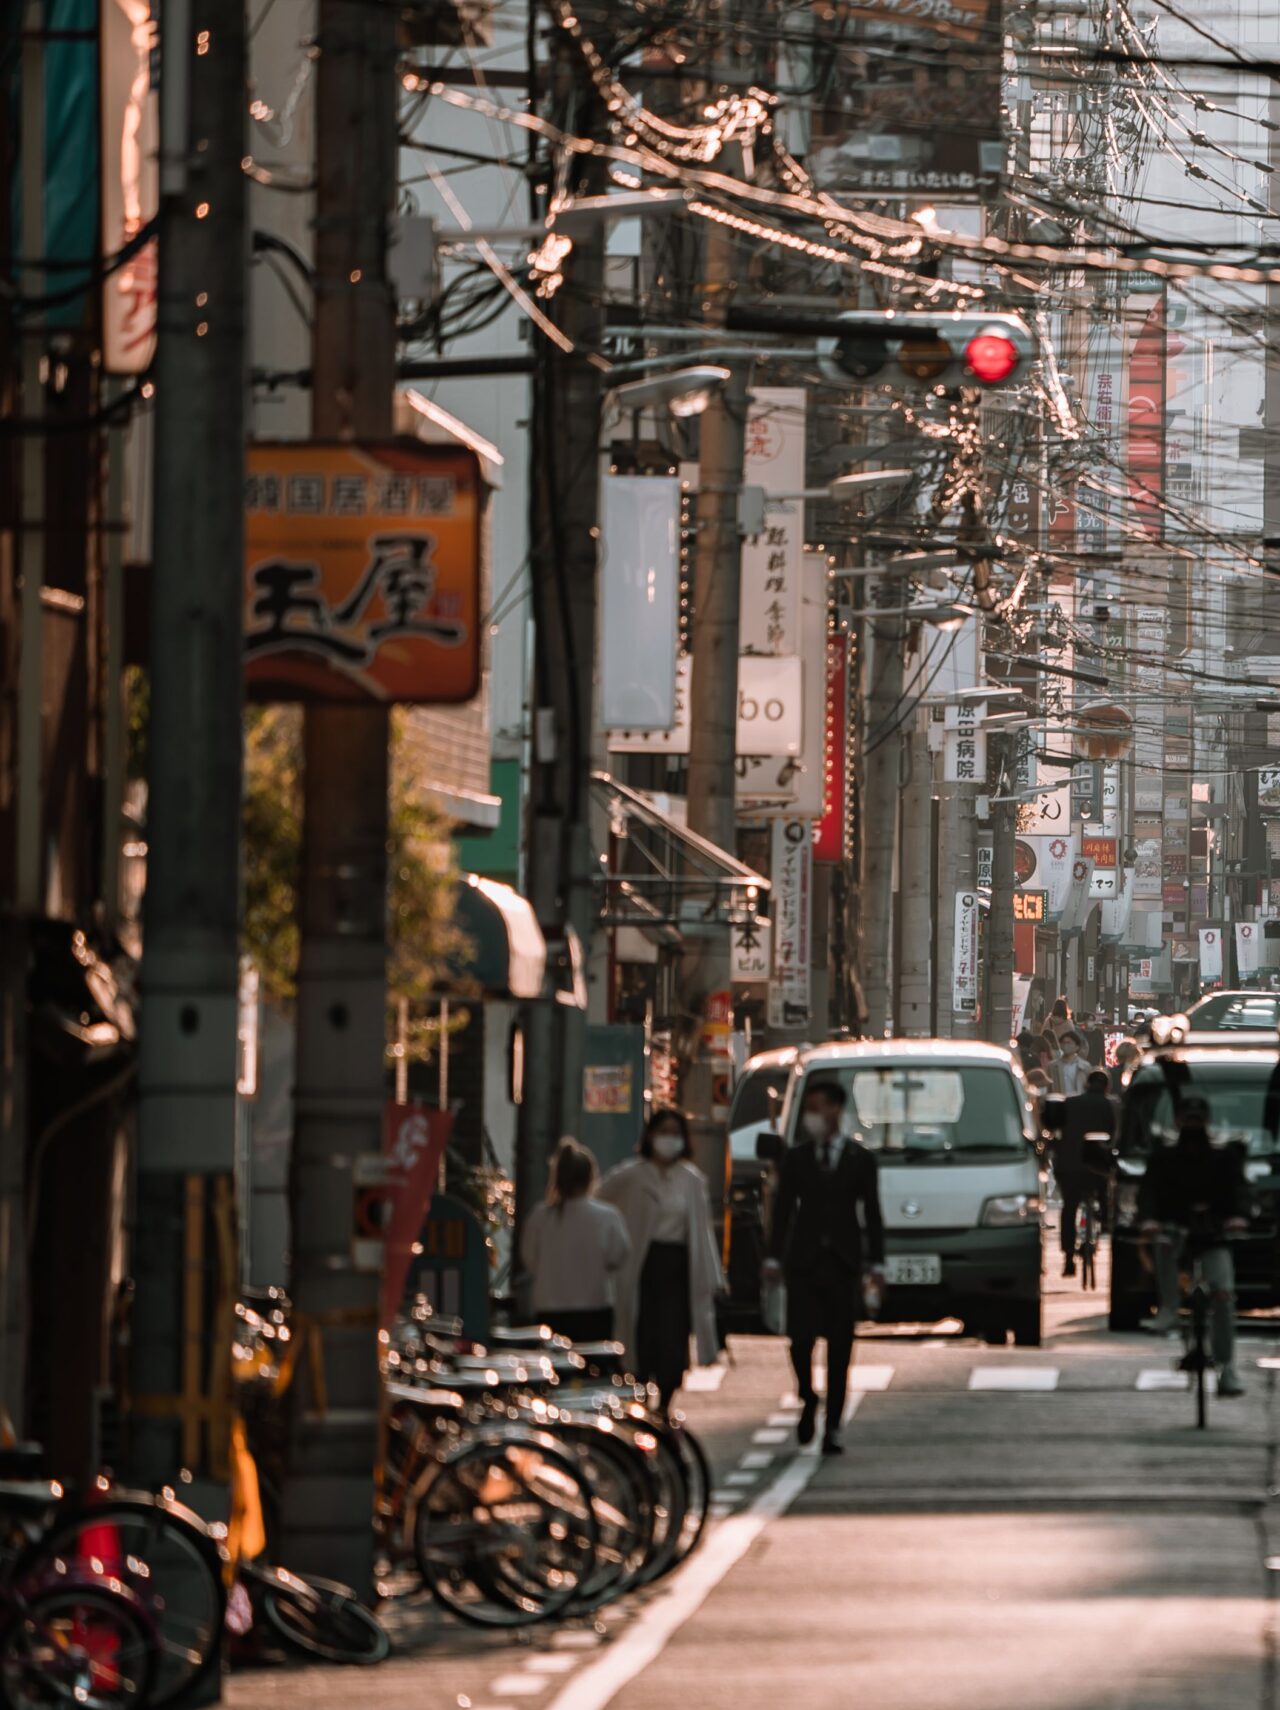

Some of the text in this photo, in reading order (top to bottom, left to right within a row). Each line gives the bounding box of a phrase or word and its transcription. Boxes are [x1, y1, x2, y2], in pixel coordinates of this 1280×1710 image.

[956, 702, 976, 779] 原田病院
[734, 920, 762, 954] 本
[737, 957, 765, 972] ビル
